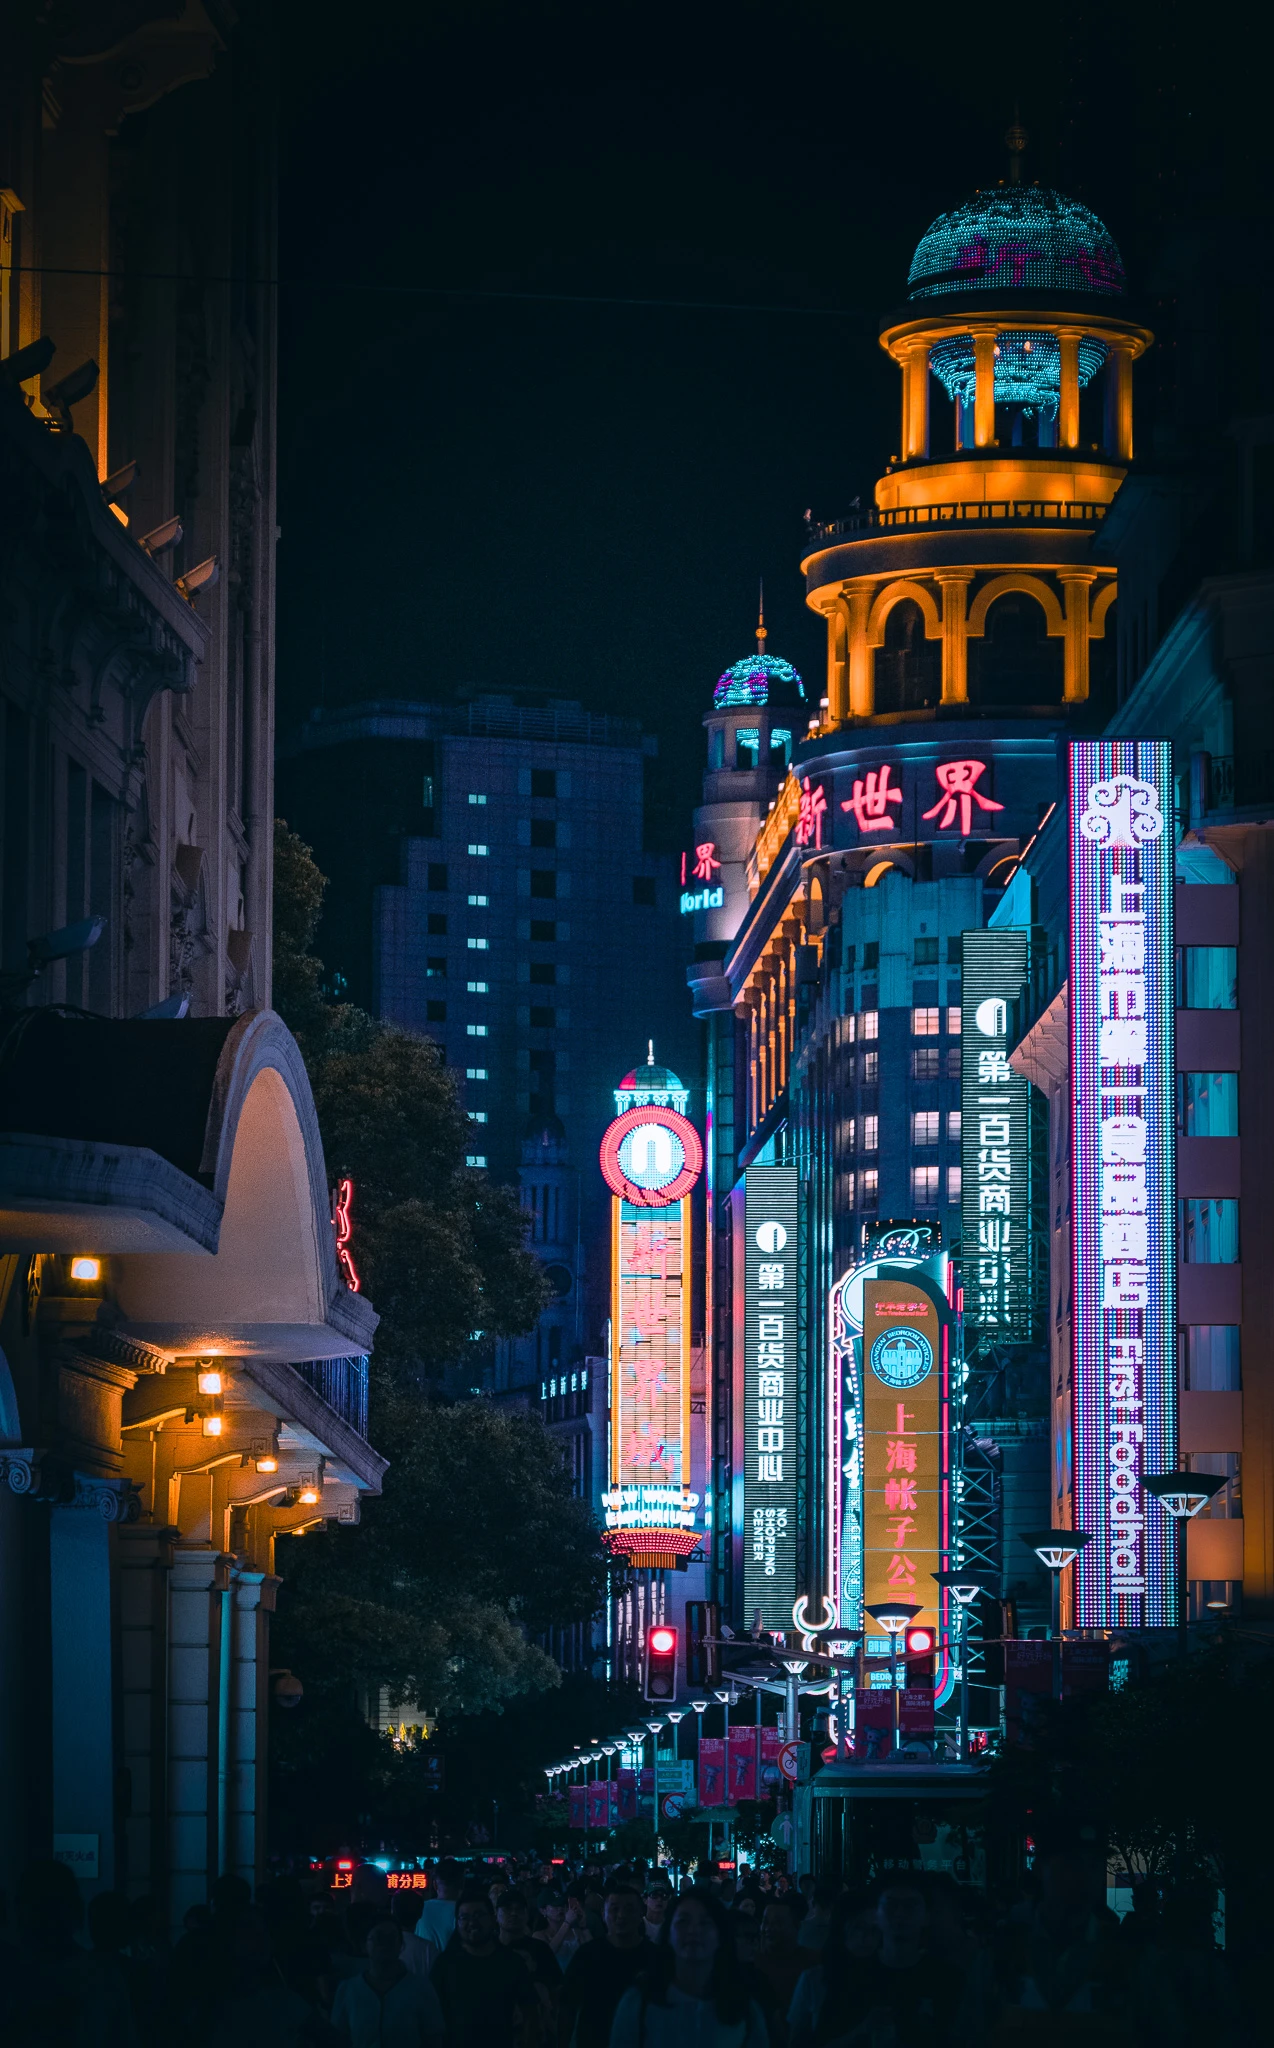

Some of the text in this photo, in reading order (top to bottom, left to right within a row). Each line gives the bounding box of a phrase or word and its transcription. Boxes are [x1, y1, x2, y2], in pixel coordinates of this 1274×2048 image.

[794, 760, 1005, 850] 新世界
[623, 1225, 680, 1473] 新世界城
[757, 1263, 785, 1481] 第一百货商业中心
[601, 1488, 700, 1508] NEW WORLD
[1109, 1338, 1145, 1594] First Foodhall
[605, 1509, 696, 1527] EMPORIUM
[753, 1508, 764, 1560] CENTER
[765, 1508, 776, 1576] SHOPPING
[776, 1508, 788, 1537] NO.1
